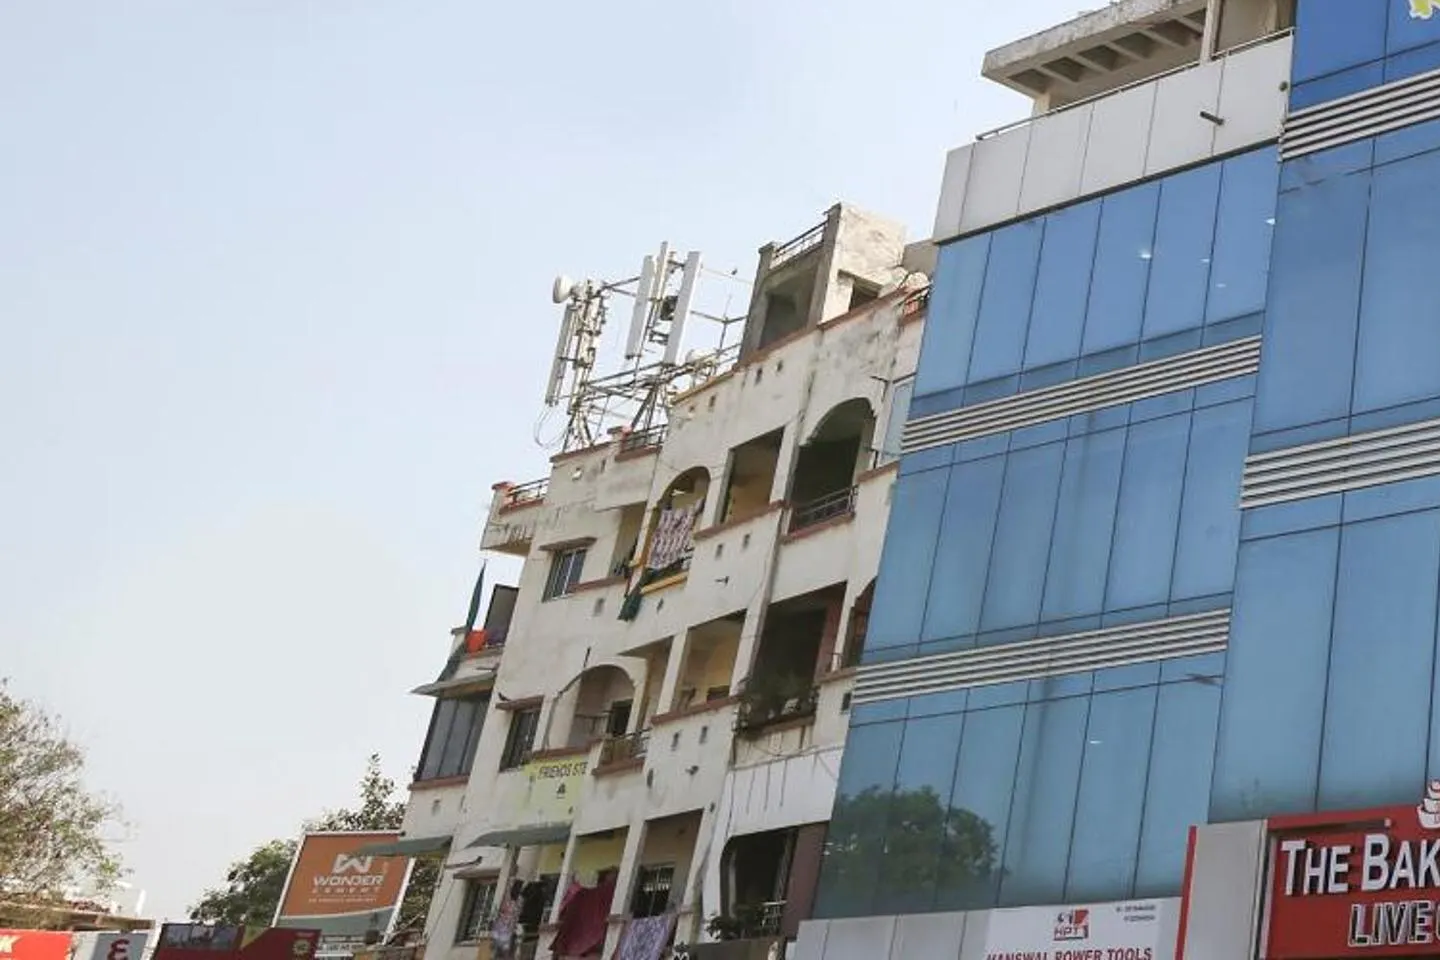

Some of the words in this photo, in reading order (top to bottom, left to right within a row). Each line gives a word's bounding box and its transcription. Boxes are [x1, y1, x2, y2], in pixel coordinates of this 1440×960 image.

[313, 874, 385, 887] WONDER
[1280, 839, 1352, 896] THE
[1347, 900, 1434, 948] LIVE
